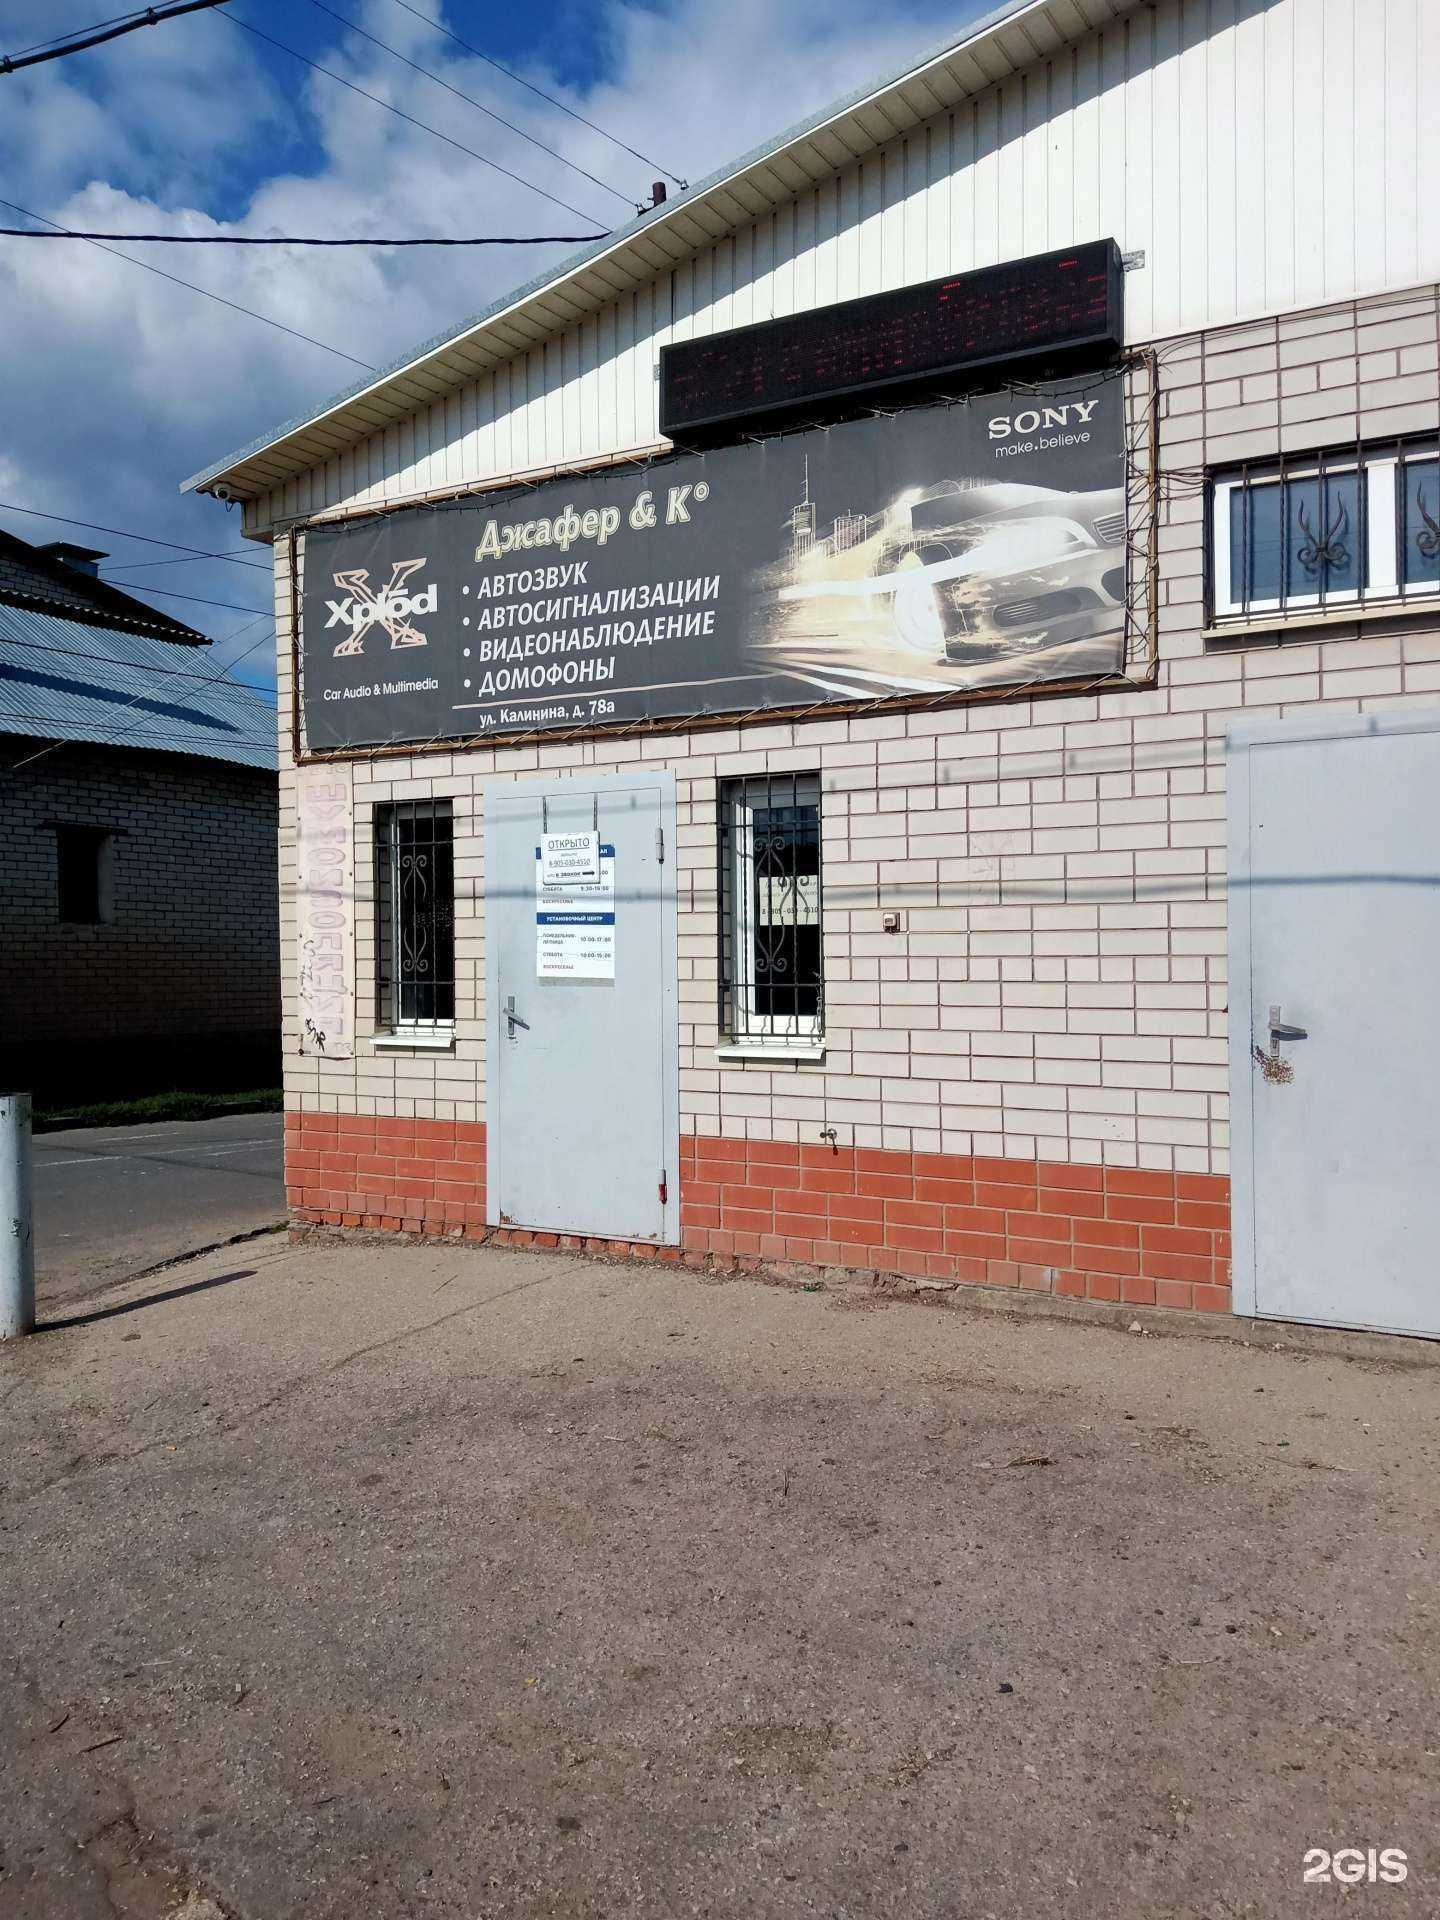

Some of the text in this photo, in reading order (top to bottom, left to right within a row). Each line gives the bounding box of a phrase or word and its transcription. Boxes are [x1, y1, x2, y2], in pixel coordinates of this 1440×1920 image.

[988, 399, 1099, 439] SONY
[995, 432, 1090, 458] make.believe
[475, 504, 621, 562] Джафер
[629, 491, 657, 530] &
[478, 561, 588, 599] АВТОЗВУК
[478, 575, 720, 631] АВТОСИГНАЛИЗАЦИИ
[480, 611, 715, 662] ВИДЕОНАБЛЮДЕНИЕ
[323, 678, 439, 701] Car Audio & Multimedia
[479, 656, 615, 697] ДОМОФОНЫ
[480, 699, 615, 728] ул. Калинина, д. 78а
[548, 837, 590, 849] ОТКРЫТО
